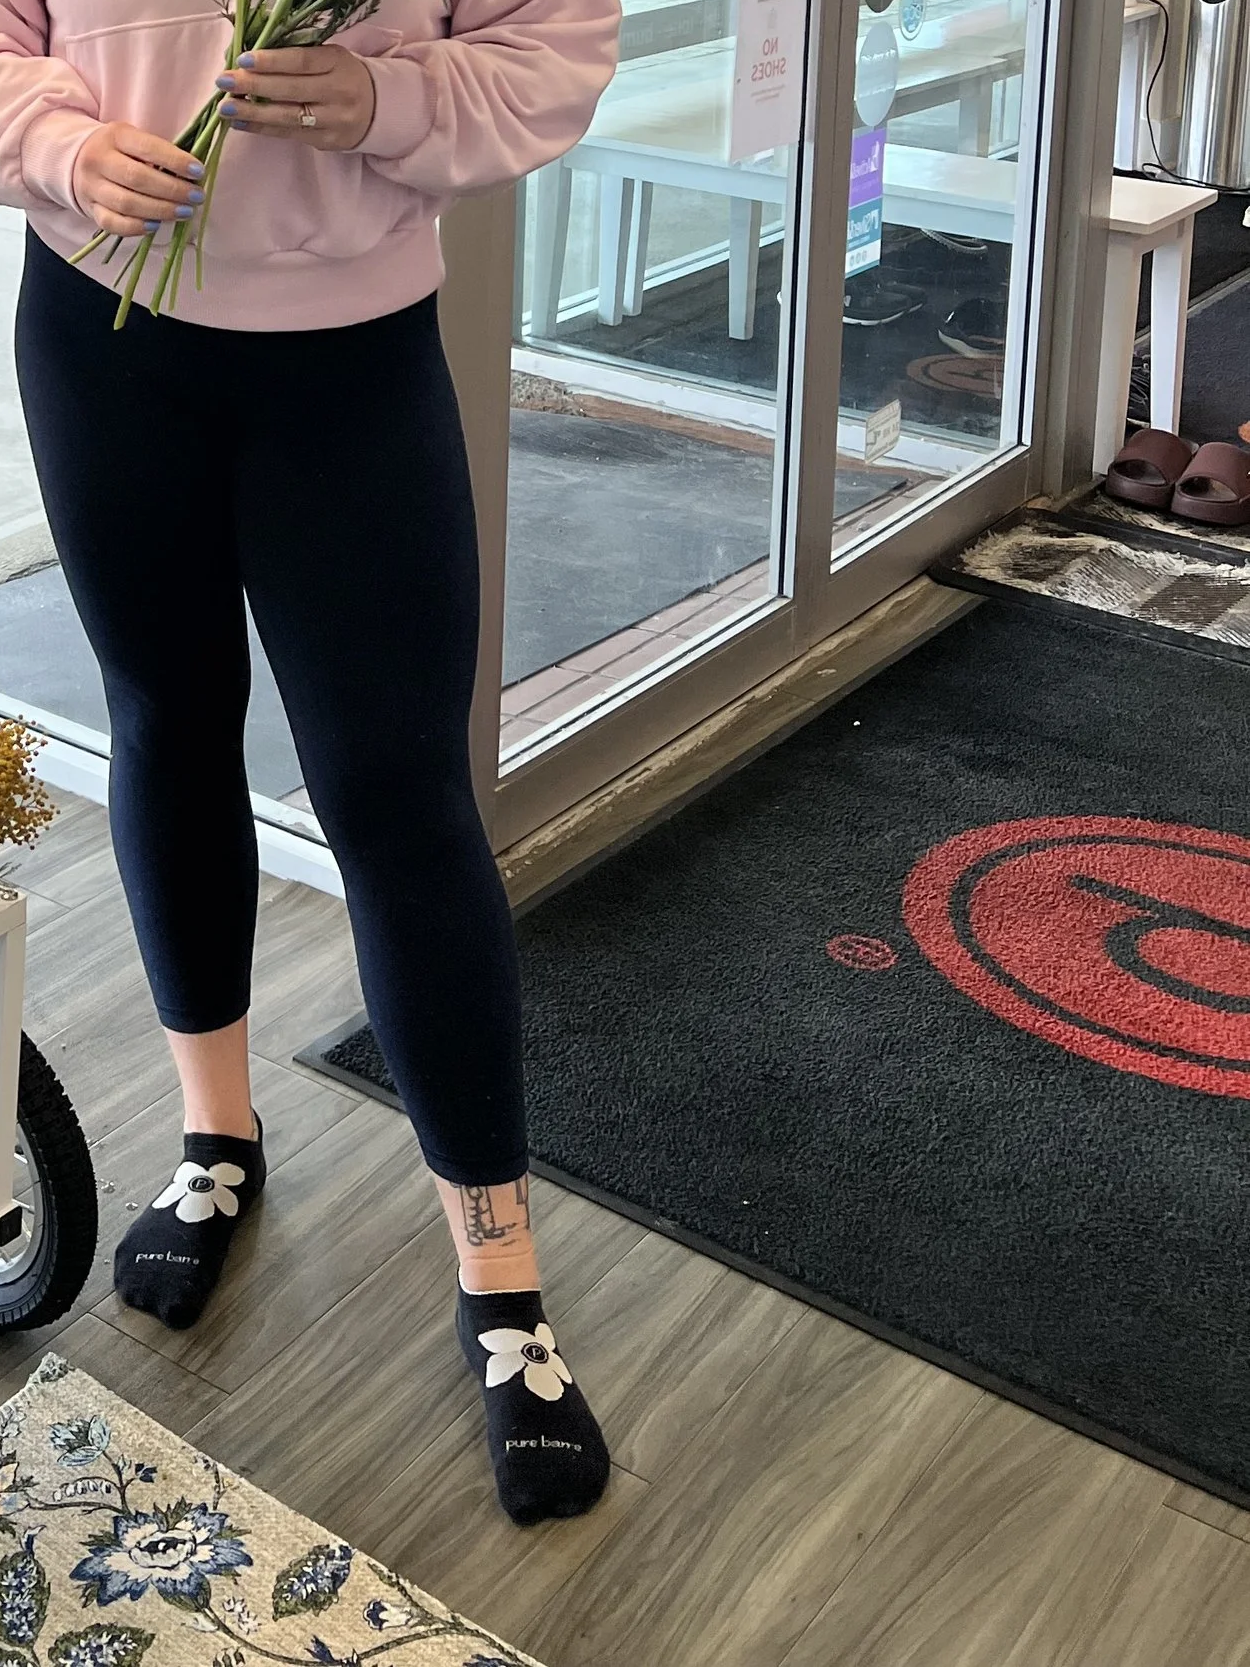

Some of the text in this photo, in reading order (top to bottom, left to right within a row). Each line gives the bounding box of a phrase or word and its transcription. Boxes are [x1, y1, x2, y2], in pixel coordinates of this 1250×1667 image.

[135, 1249, 200, 1265] pure barre
[505, 1435, 582, 1453] pure barre
